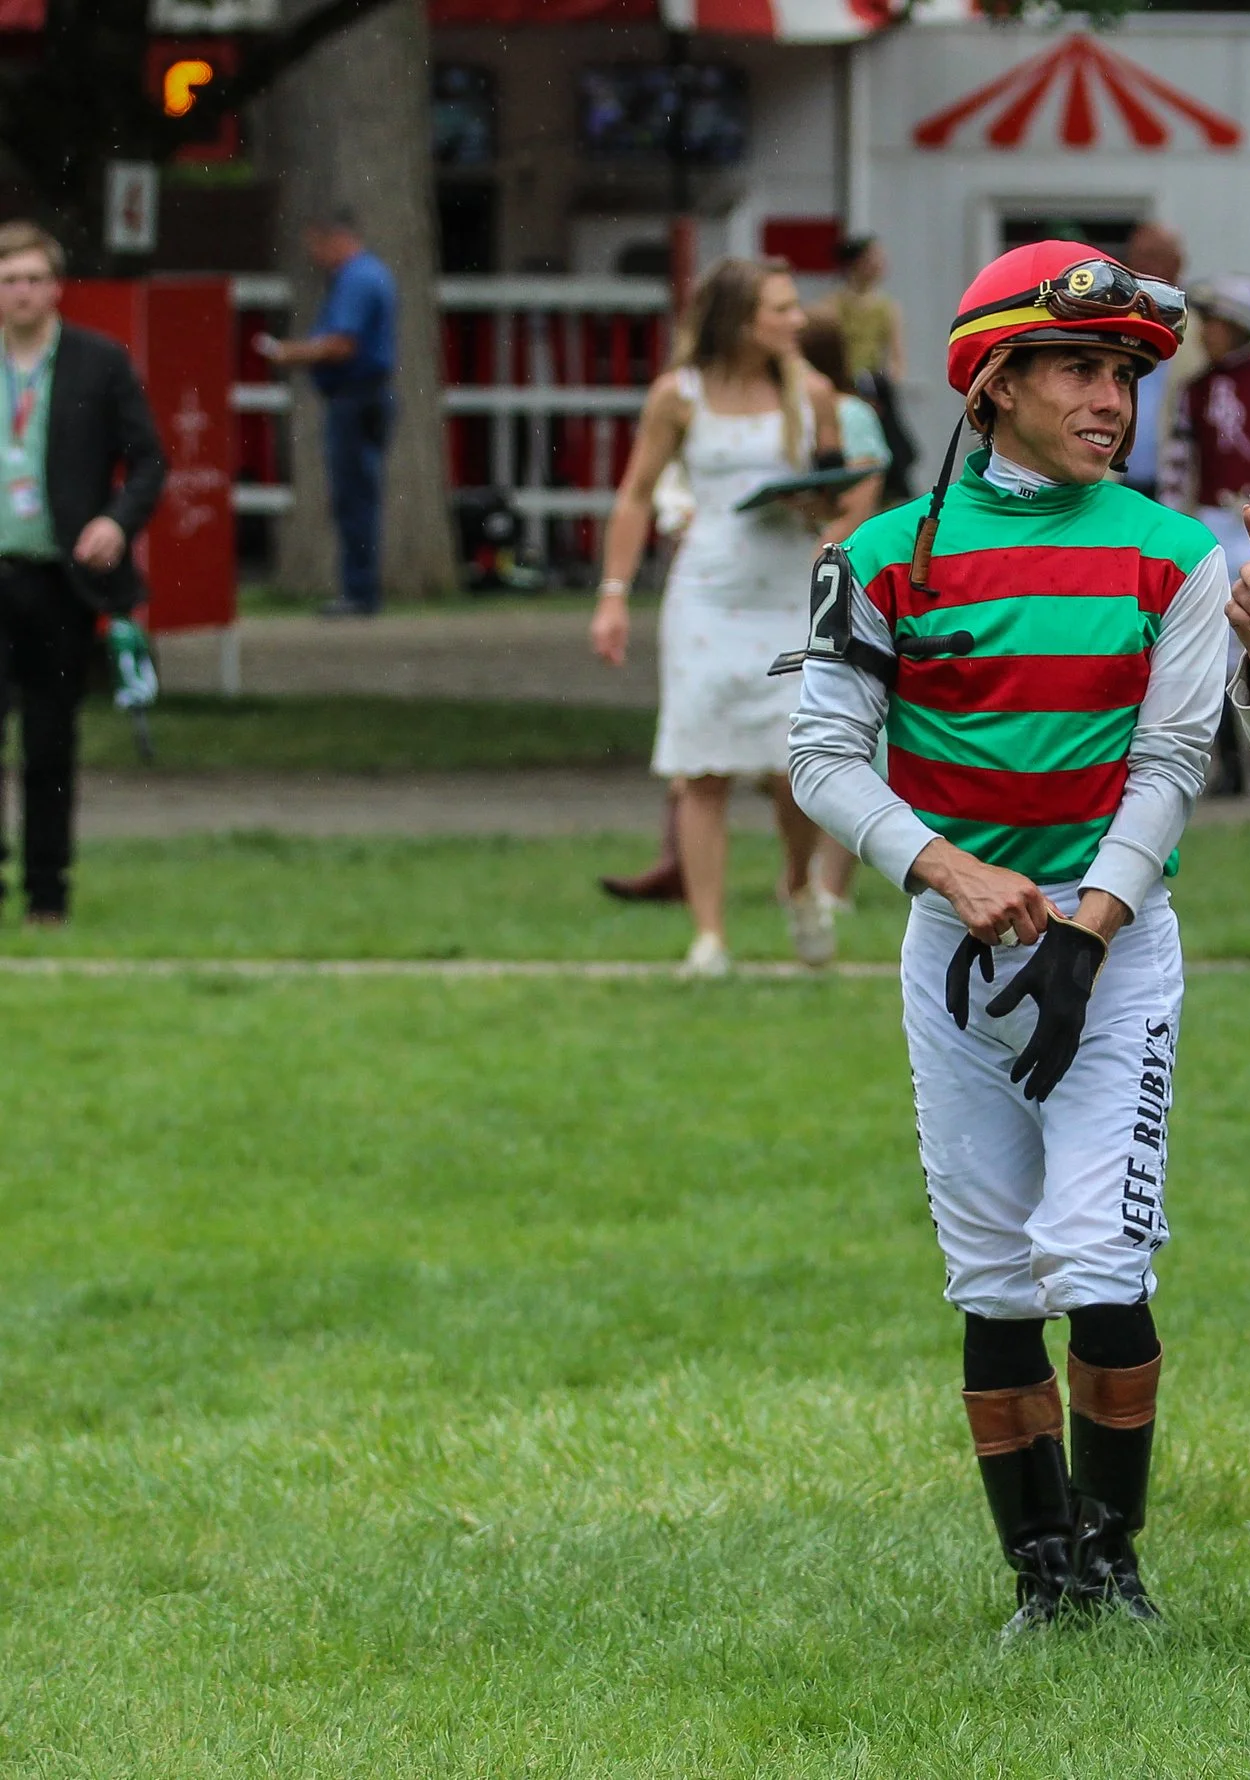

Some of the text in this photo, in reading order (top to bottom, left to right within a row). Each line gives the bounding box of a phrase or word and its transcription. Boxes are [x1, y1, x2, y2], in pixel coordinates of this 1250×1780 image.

[809, 563, 840, 653] 2
[1133, 1018, 1170, 1151] RUBY'S
[1122, 1156, 1157, 1247] JEFF
